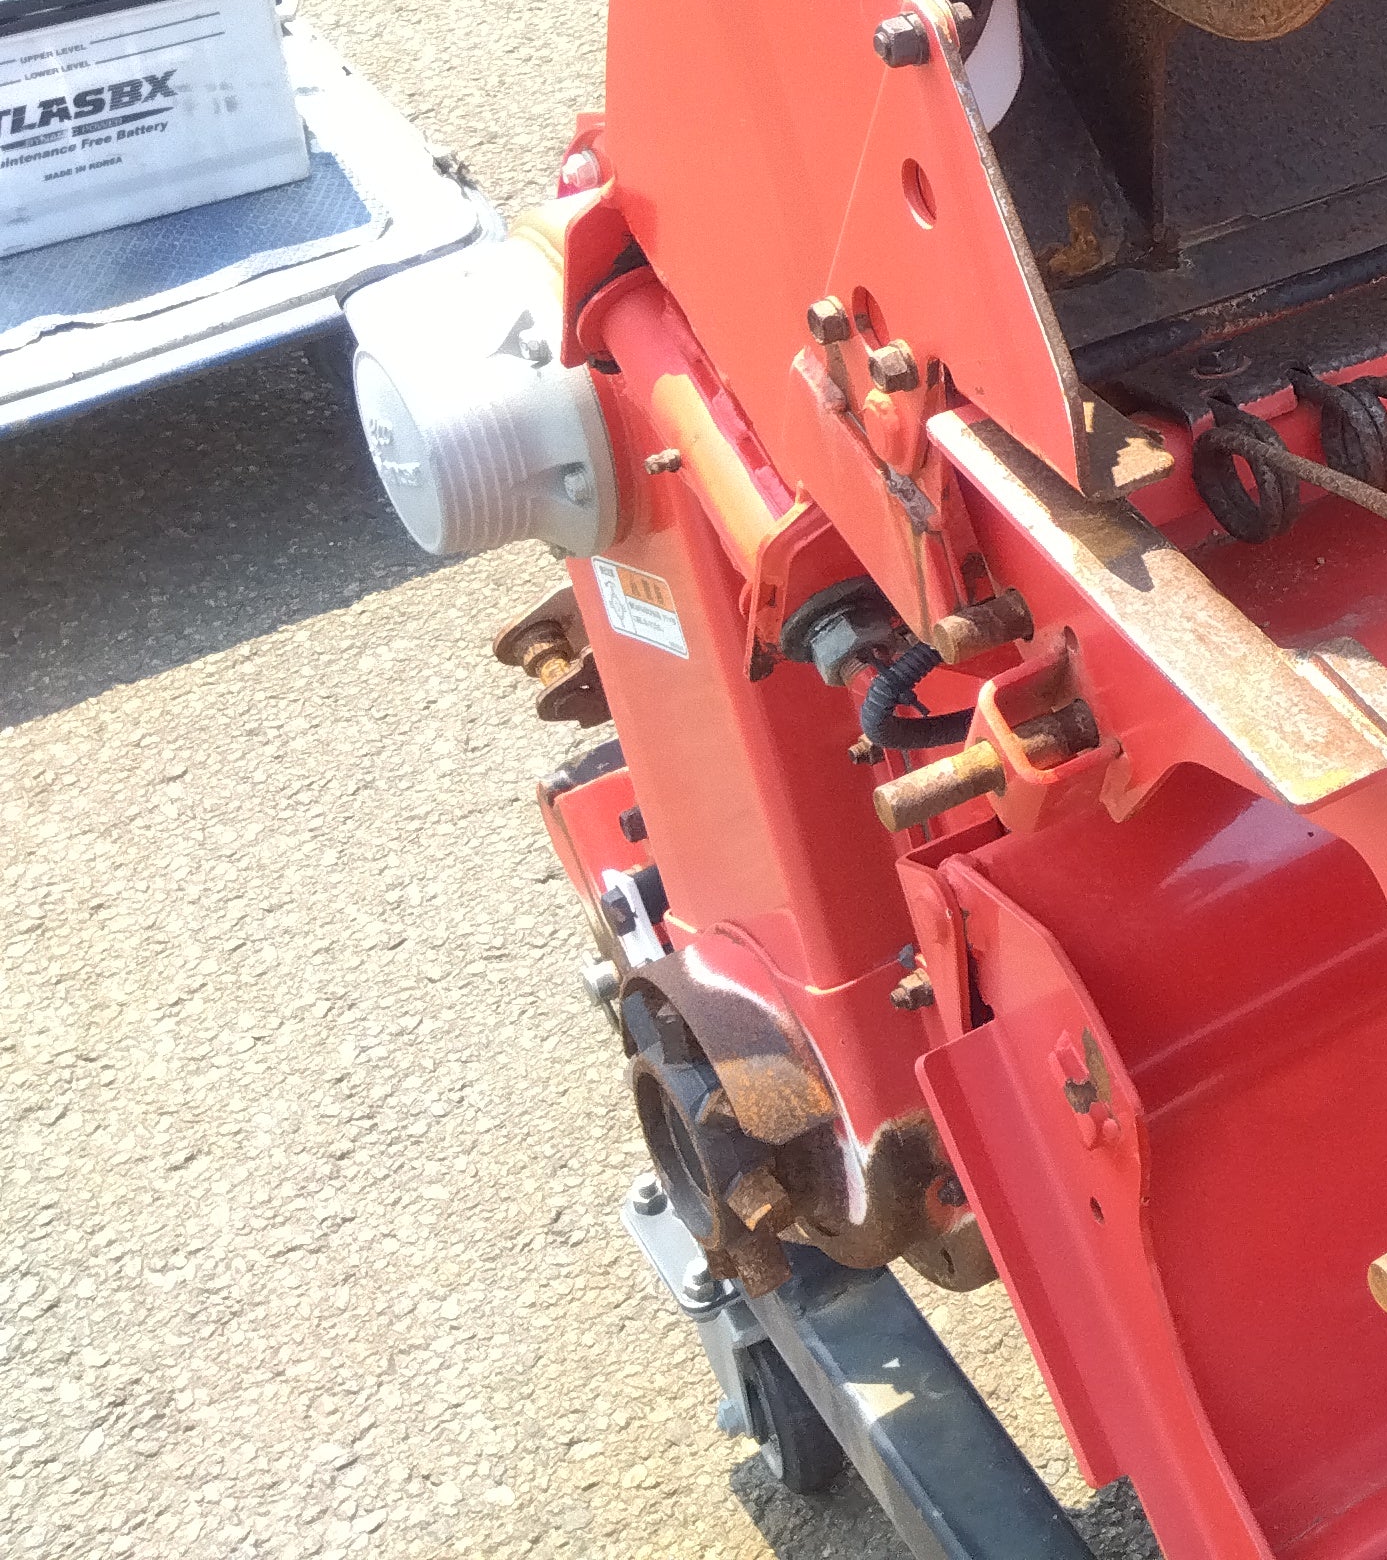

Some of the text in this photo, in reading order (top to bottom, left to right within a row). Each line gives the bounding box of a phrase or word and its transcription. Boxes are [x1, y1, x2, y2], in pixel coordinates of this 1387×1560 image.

[19, 44, 87, 64] UPPER LEVEL
[24, 59, 91, 81] LOWER LEVEL
[81, 135, 112, 149] Free
[117, 121, 169, 141] Battery
[43, 156, 123, 182] MADE IN KOREA
